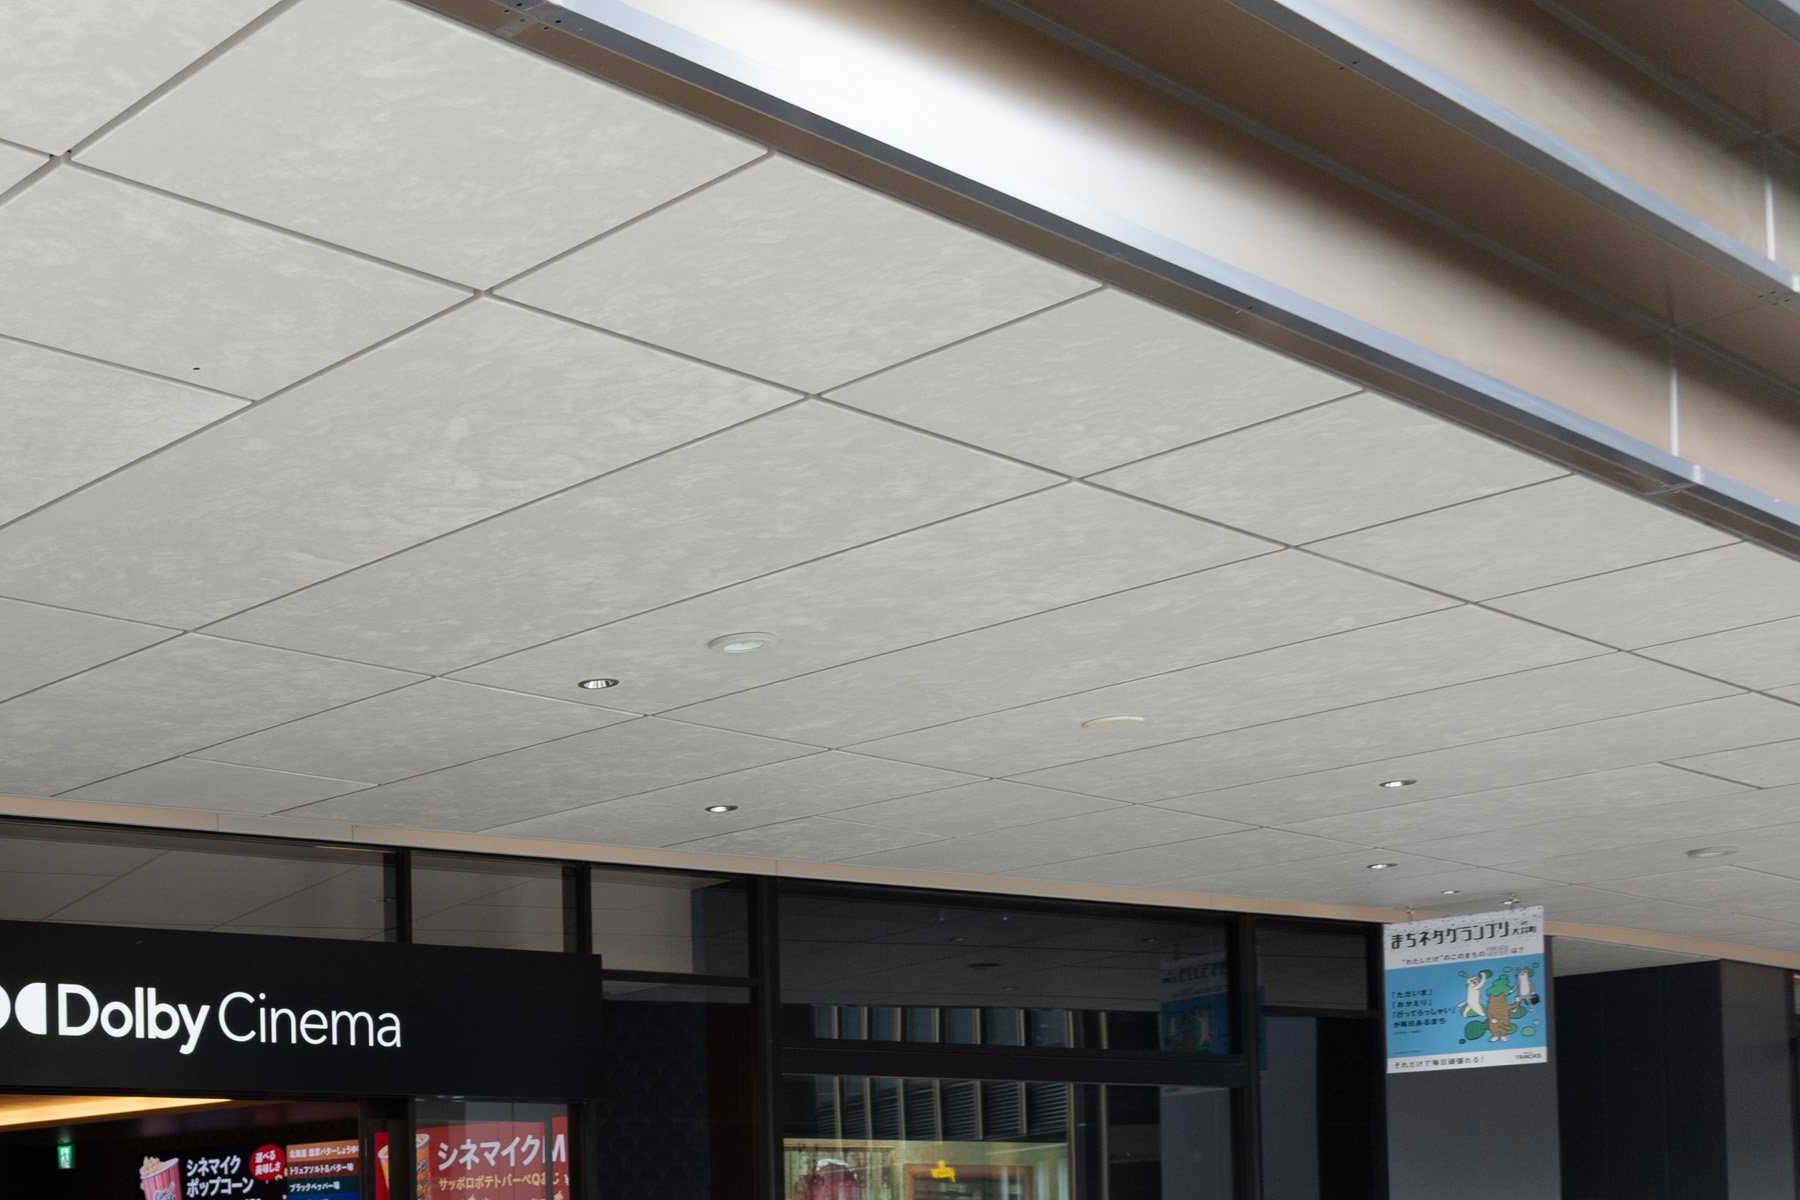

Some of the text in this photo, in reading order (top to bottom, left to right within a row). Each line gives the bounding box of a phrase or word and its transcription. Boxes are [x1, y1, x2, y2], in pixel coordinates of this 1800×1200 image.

[1391, 921, 1509, 950] まちネタグランプリ
[1512, 926, 1537, 936] 大井町
[57, 983, 401, 1055] Dolby Cinema
[1393, 1018, 1446, 1028] が毎日あるまち
[255, 1150, 276, 1163] 選べる
[186, 1155, 241, 1177] シネマイク
[255, 1161, 281, 1175] 美味しさ
[186, 1177, 254, 1198] ポップコーン
[289, 1181, 340, 1193] ブラックペッパー味
